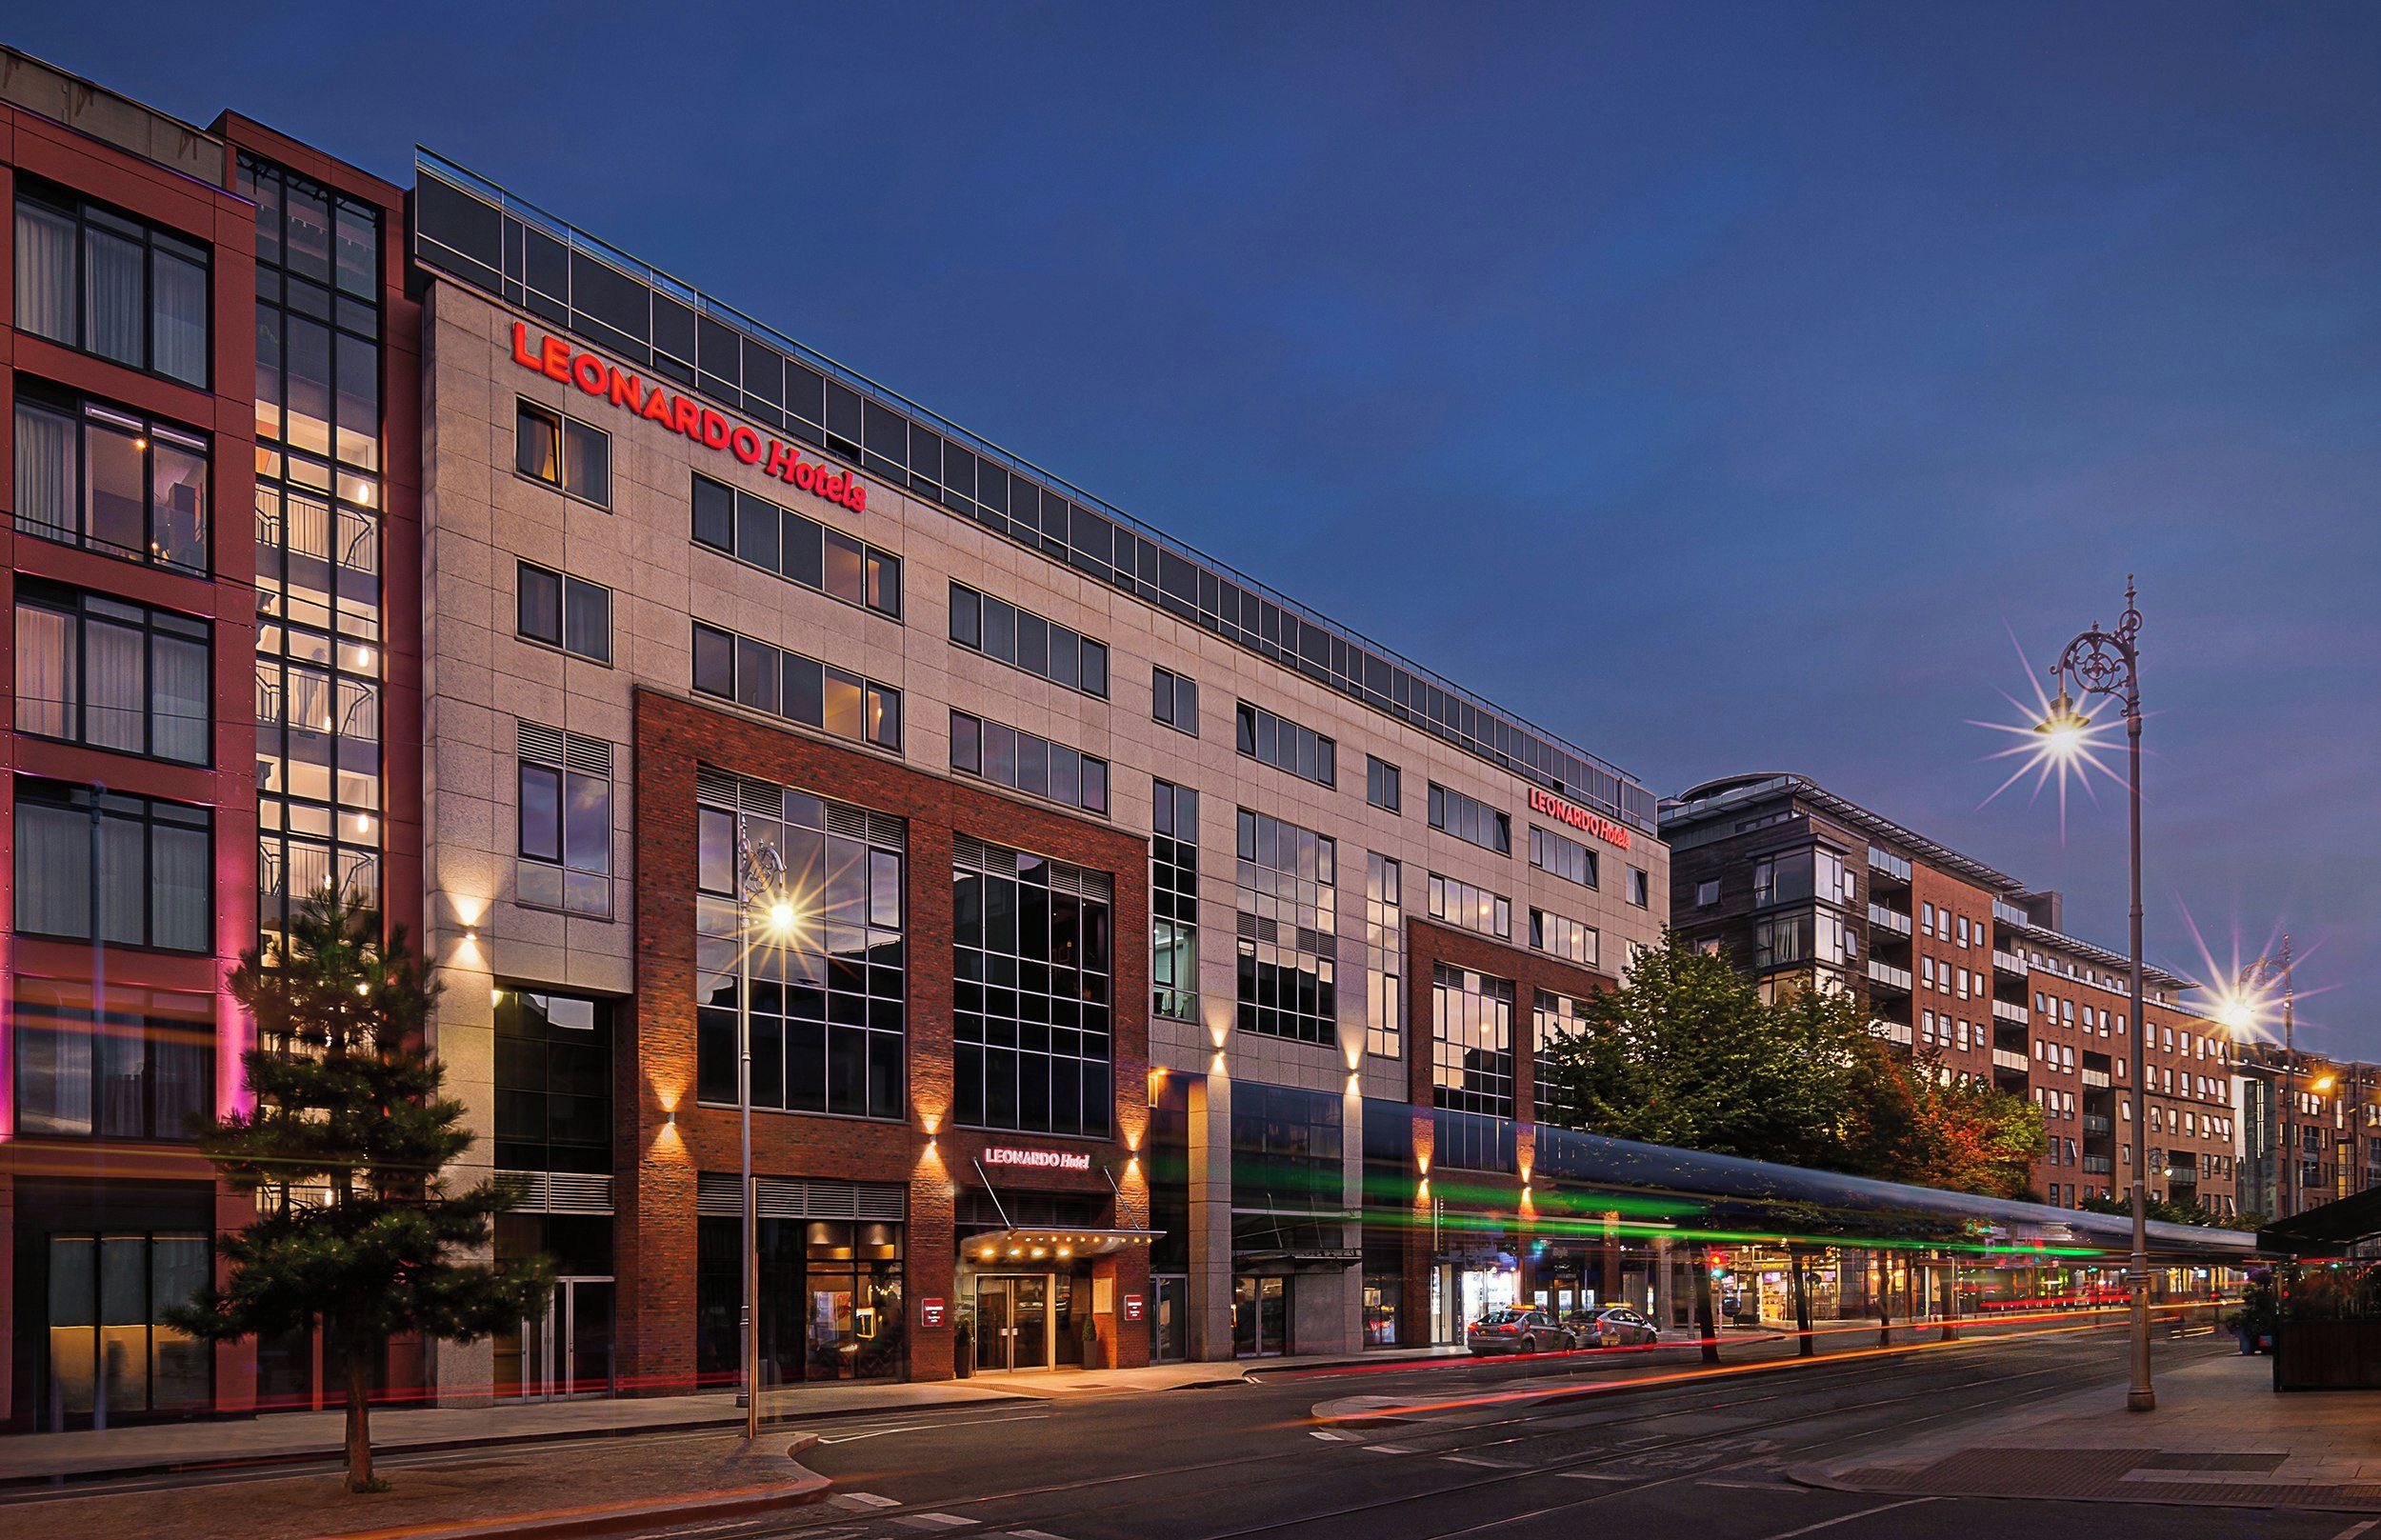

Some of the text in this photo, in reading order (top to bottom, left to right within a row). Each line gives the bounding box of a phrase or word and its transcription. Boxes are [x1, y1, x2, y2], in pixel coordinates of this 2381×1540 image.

[512, 321, 868, 513] LEONARDO Hotels
[1529, 786, 1631, 851] LEONARDO Hotels
[985, 1148, 1090, 1170] LEONARDO Hotel
